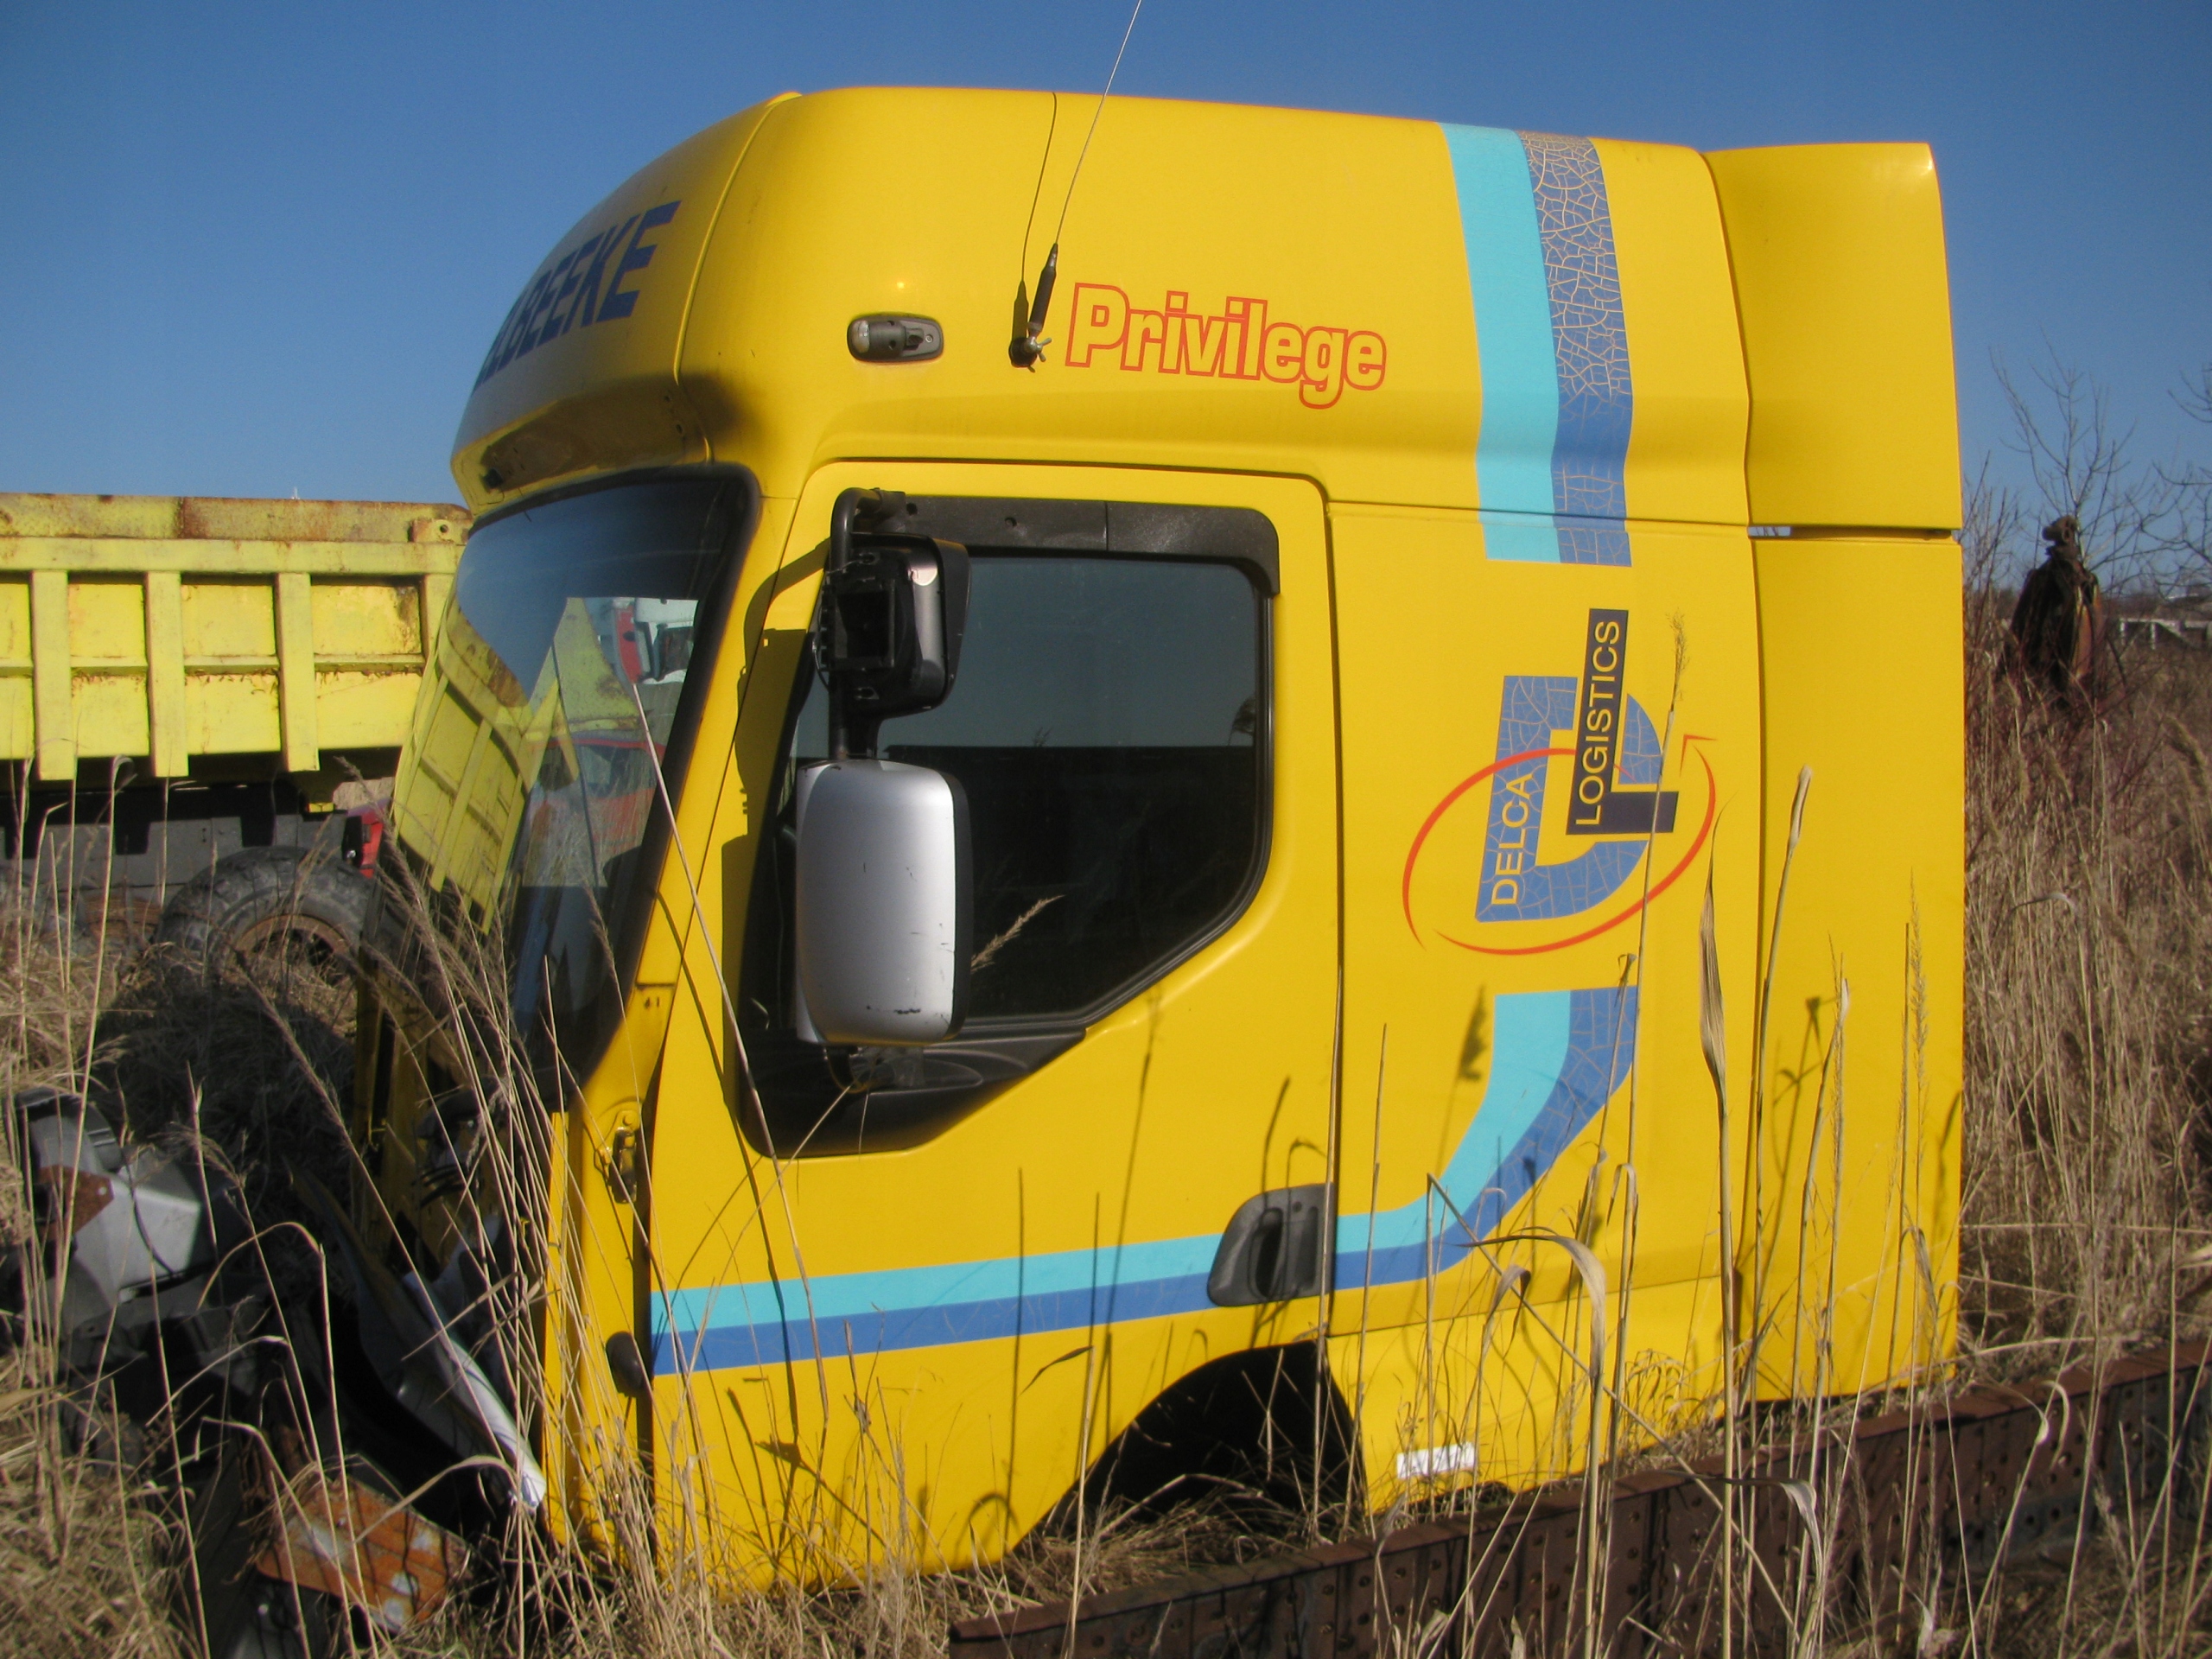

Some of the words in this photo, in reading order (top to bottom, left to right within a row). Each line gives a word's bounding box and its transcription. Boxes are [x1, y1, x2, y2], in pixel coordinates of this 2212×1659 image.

[1065, 282, 1387, 410] Privilege
[1574, 620, 1621, 826] LOGISTICS
[1491, 772, 1534, 906] DELCA
